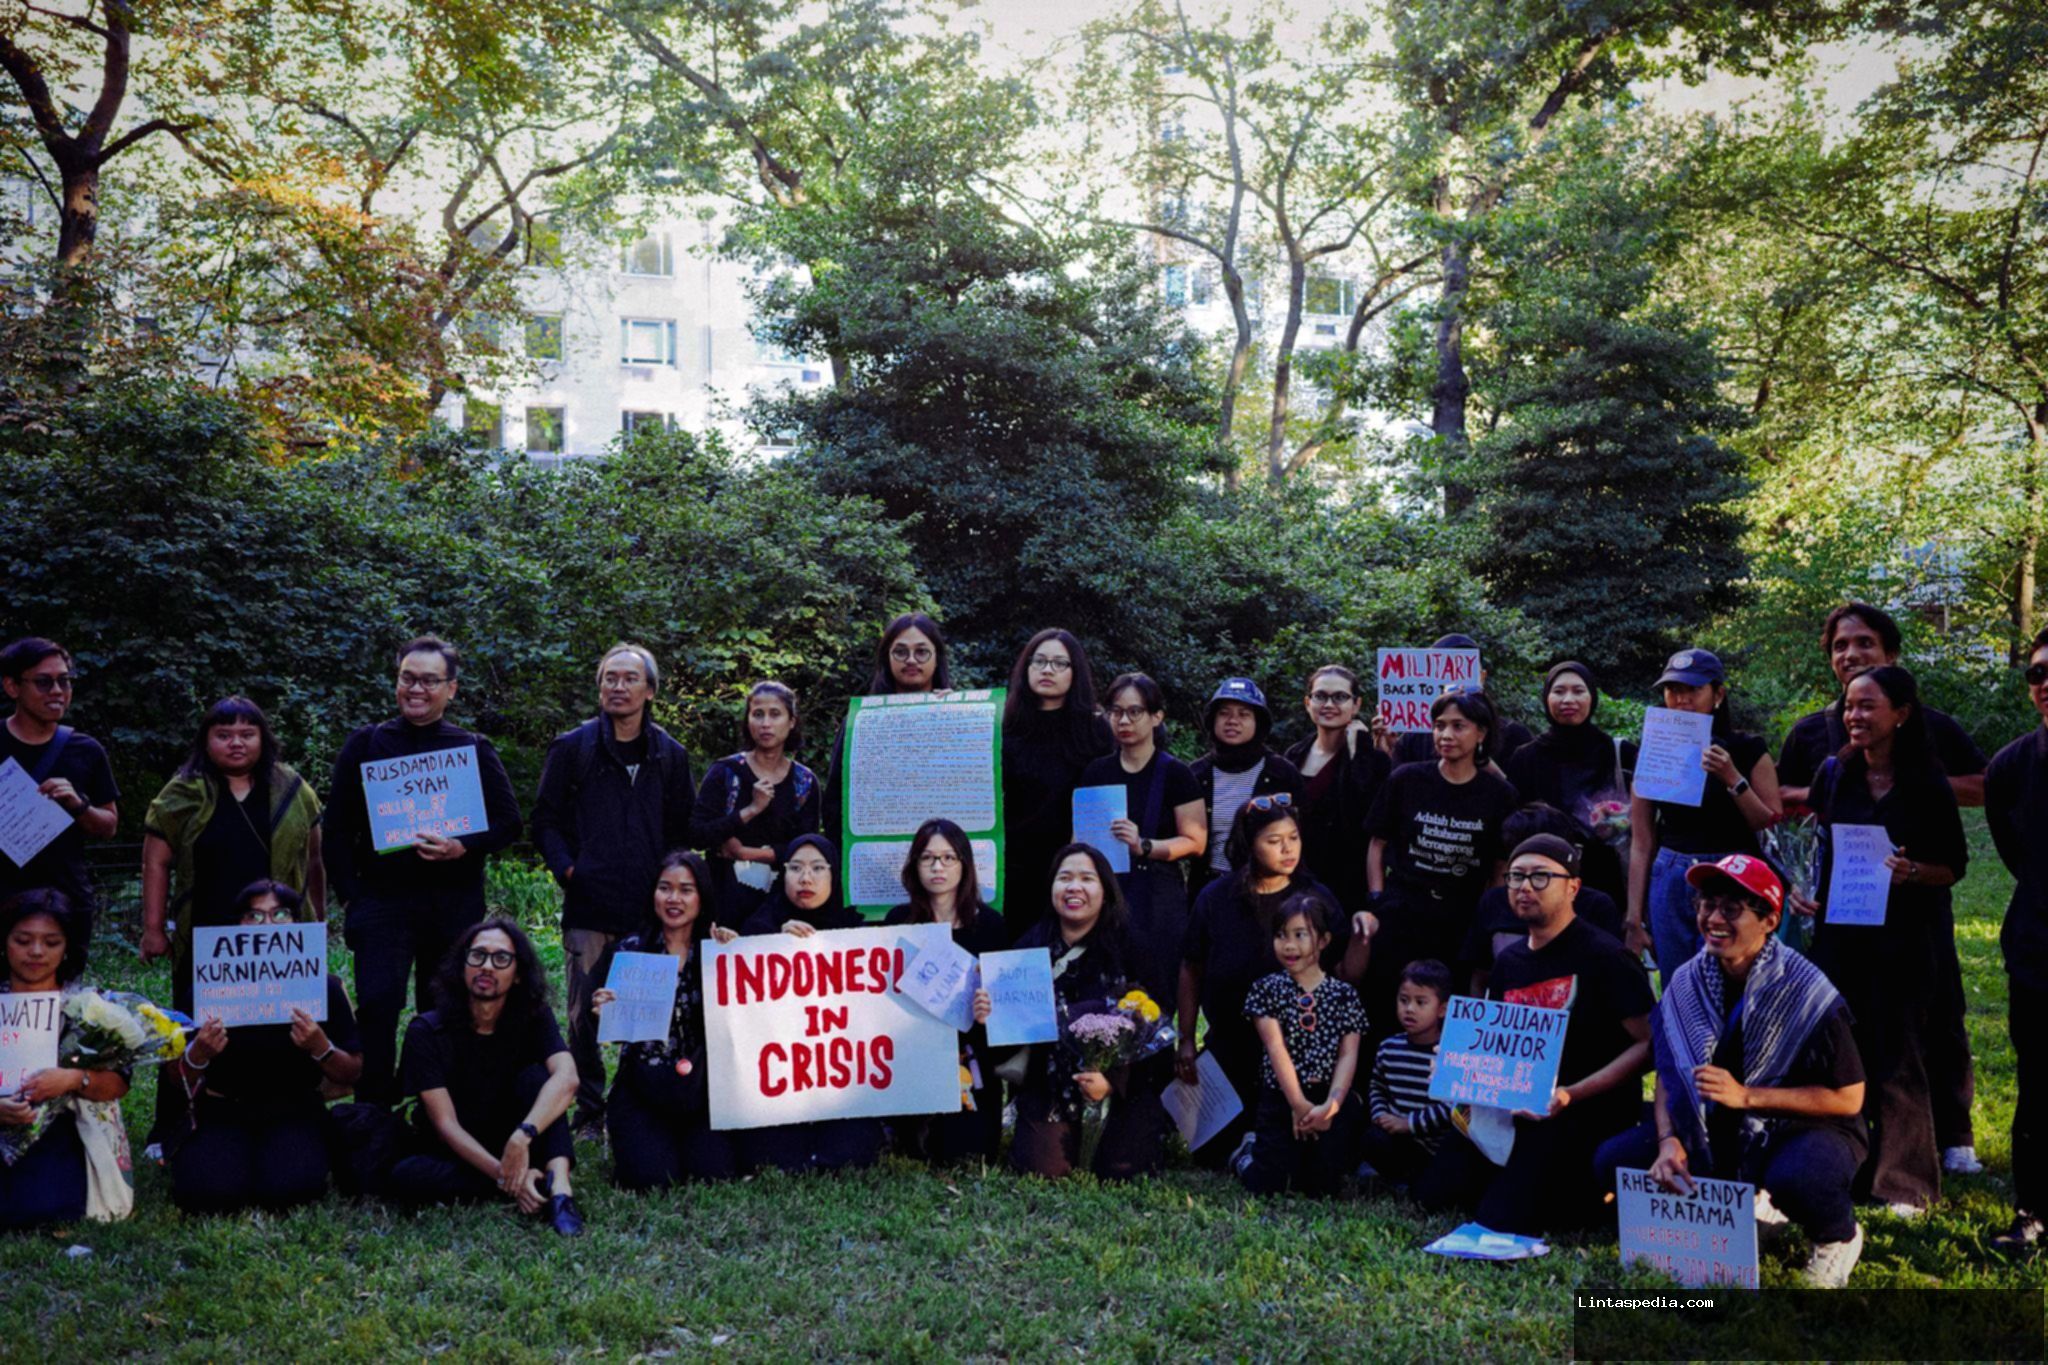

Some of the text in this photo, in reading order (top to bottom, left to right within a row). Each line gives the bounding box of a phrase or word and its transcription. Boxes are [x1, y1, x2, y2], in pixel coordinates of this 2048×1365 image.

[1381, 653, 1477, 681] MILITARY
[1383, 683, 1415, 695] BACK
[1418, 683, 1434, 696] TO
[1381, 699, 1433, 729] BARR
[365, 751, 468, 783] RUSDAMDIAN
[1414, 811, 1449, 827] Adalah
[212, 930, 304, 958] AFFAN
[196, 957, 320, 984] KURNIAWAN
[716, 947, 904, 1006] INDONESI
[805, 1005, 848, 1037] IN
[1452, 999, 1567, 1037] IKO JULIANT
[1468, 1028, 1547, 1061] JUNIOR
[758, 1035, 894, 1098] CRISIS
[1622, 1173, 1684, 1196] RHE
[1650, 1198, 1735, 1229] PRATAMA
[1711, 1234, 1729, 1255] BY
